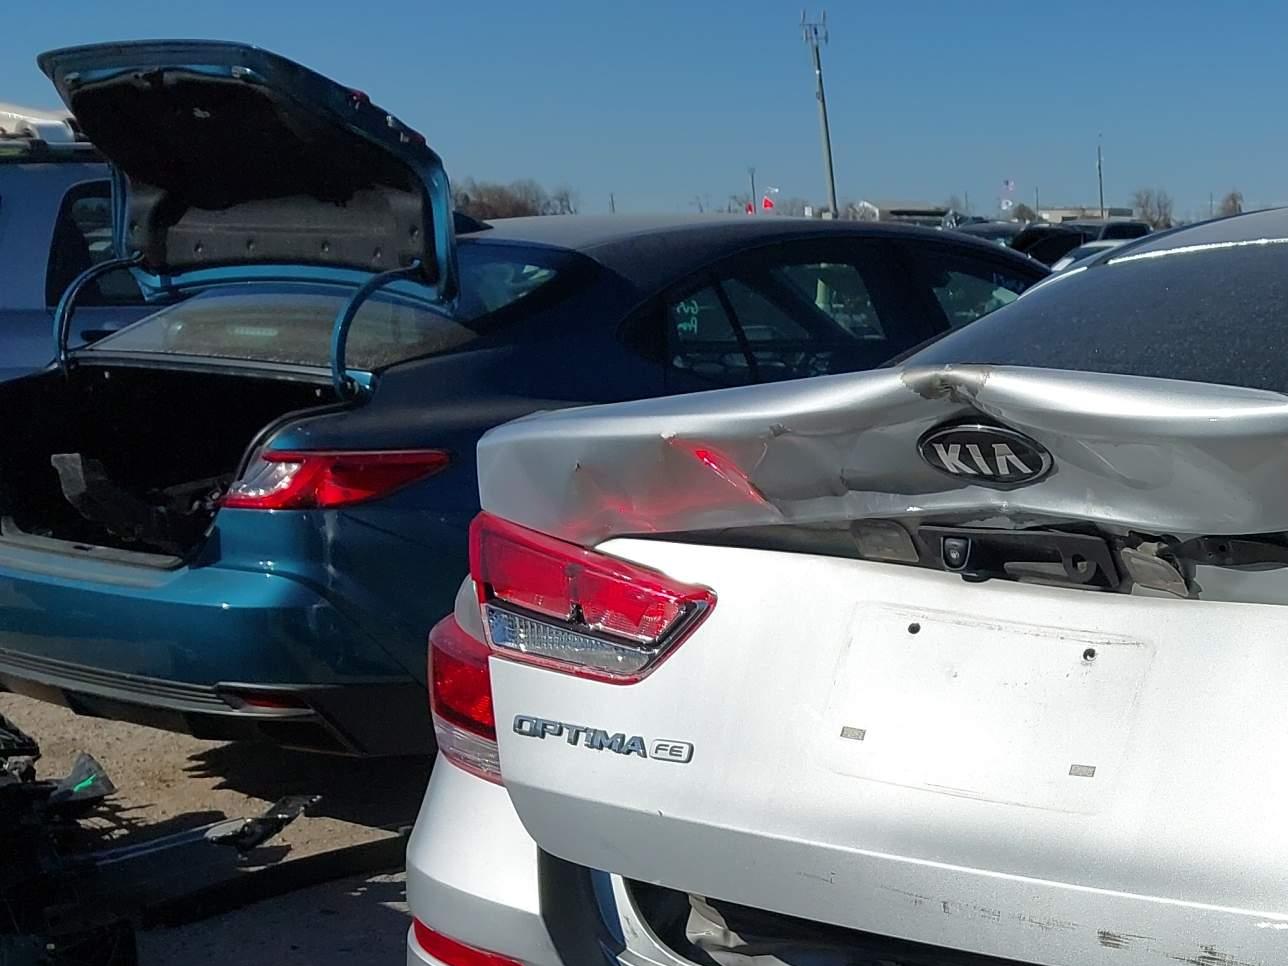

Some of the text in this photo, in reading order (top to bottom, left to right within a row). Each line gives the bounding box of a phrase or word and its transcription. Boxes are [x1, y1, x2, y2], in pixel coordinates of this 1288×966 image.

[932, 443, 1033, 476] KIA
[513, 714, 684, 759] OPTIMA FE
